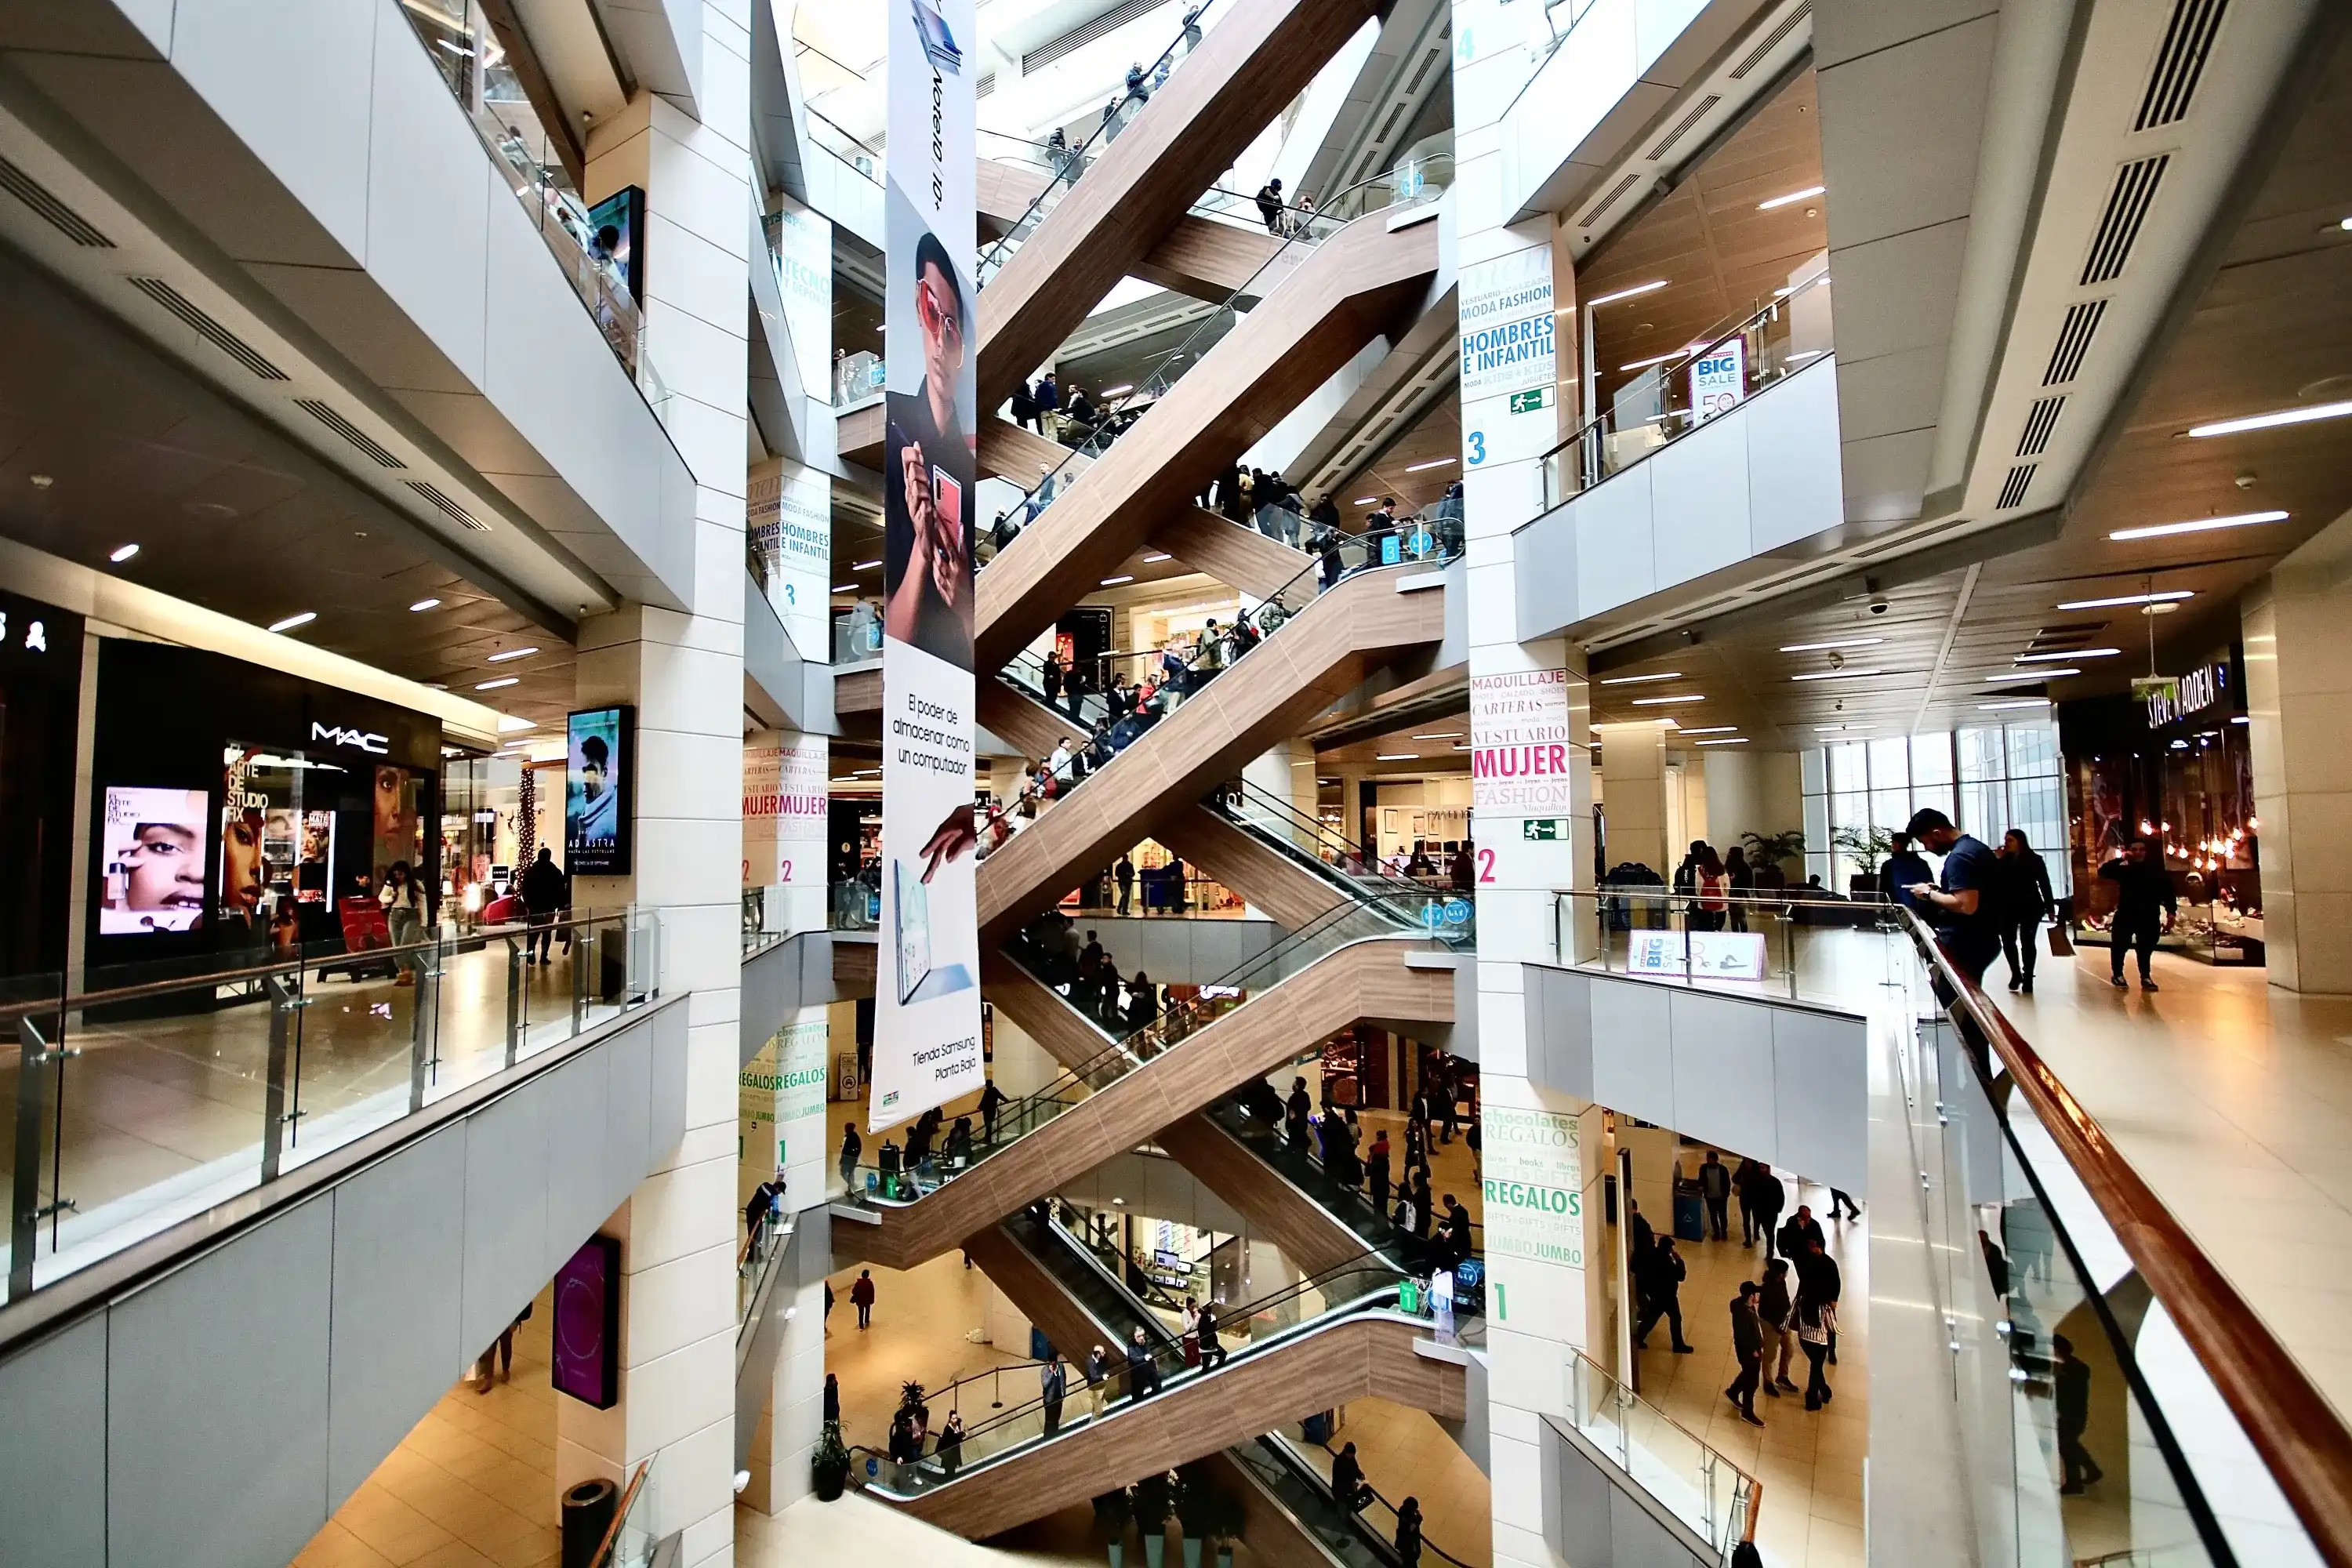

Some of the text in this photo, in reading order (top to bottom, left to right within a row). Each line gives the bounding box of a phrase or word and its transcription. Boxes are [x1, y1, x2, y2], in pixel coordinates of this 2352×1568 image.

[1457, 28, 1475, 60] 4
[932, 65, 943, 162] Note10
[785, 256, 830, 296] TECNO
[1461, 300, 1497, 321] MODA
[1499, 285, 1552, 311] FASHION
[1463, 314, 1555, 356] HOMBRES
[1464, 336, 1555, 375] E INFANTIL
[1698, 358, 1736, 376] BIG
[1464, 379, 1482, 390] MODA
[1522, 372, 1557, 386] JUGUETES
[1699, 373, 1736, 387] SALE
[1468, 431, 1486, 465] 3
[782, 502, 803, 515] MODA
[803, 510, 829, 524] FASHION
[749, 521, 780, 541] OMBRES
[782, 522, 829, 547] HOMBRES
[782, 536, 829, 560] E INFANTIL
[1386, 546, 1395, 560] 3
[1472, 671, 1565, 691] MAQUILLAJE
[1541, 686, 1566, 695] SHOES
[909, 694, 957, 724] El poder de
[1472, 699, 1543, 717] CARTERAS
[893, 718, 970, 752] almacenar como
[1473, 725, 1566, 745] VESTUARIO
[745, 748, 779, 760] AQUILLAJE
[779, 747, 827, 761] MAQUILLAJE
[898, 748, 967, 775] un computador
[1473, 745, 1567, 779] MUJER
[229, 760, 259, 778] ARTE
[744, 765, 769, 775] ARTERAS
[779, 764, 816, 775] CARTERAS
[228, 775, 245, 792] DE
[744, 784, 779, 795] ESTUARIO
[779, 783, 827, 795] VESTUARIO
[227, 792, 269, 809] STUDIO
[779, 795, 827, 815] MUJER
[1475, 786, 1569, 805] FASHION
[228, 806, 244, 822] FIX
[568, 838, 615, 848] AD ASTRA
[782, 860, 792, 882] 2
[1478, 848, 1496, 883] 2
[1647, 938, 1664, 967] BIG
[913, 1036, 975, 1066] Tienda Samsung
[935, 1056, 976, 1082] Planta Baja
[739, 1072, 775, 1091] EGALOS
[775, 1068, 825, 1091] REGALOS
[801, 1102, 826, 1116] JUMBO
[1483, 1108, 1578, 1131] chocolates
[1485, 1123, 1579, 1149] REGALOS
[779, 1140, 786, 1163] 1
[1519, 1157, 1544, 1168] books
[1556, 1161, 1581, 1173] libros
[1485, 1180, 1581, 1217] REGALOS
[1553, 1224, 1581, 1236] GIFTS
[1534, 1243, 1581, 1264] JUMBO
[1404, 1292, 1410, 1308] 1
[1494, 1283, 1508, 1321] 1
